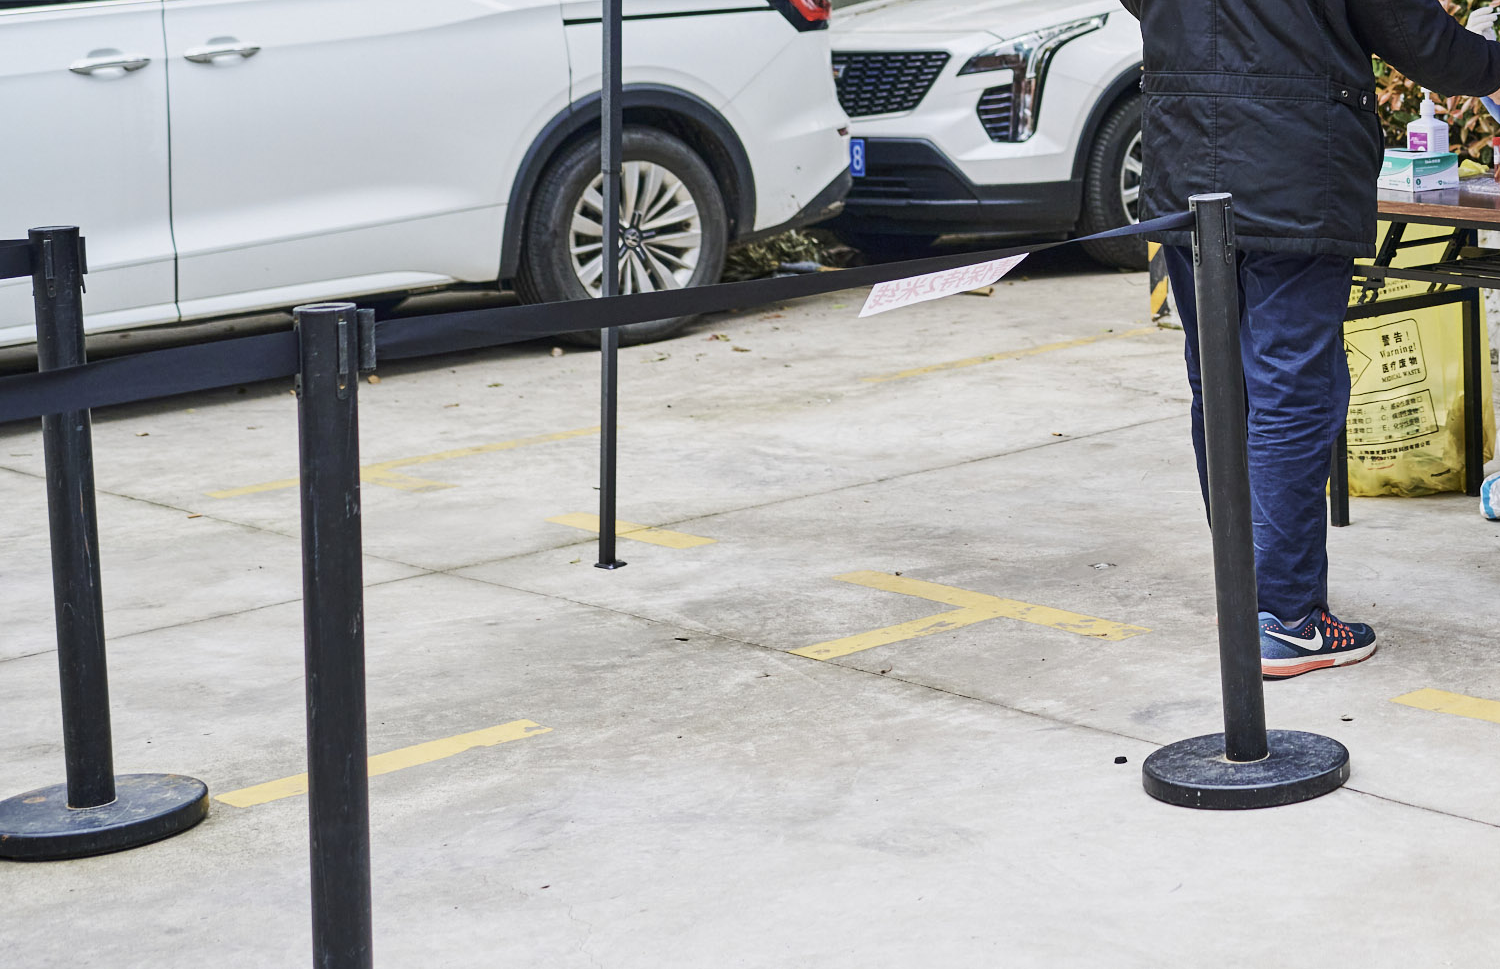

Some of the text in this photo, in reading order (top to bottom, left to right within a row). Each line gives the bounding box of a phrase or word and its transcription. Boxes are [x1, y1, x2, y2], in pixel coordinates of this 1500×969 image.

[1380, 342, 1417, 358] Warning!
[1382, 356, 1418, 374] 医疗废物
[1381, 368, 1421, 383] MEDICAL WASTE
